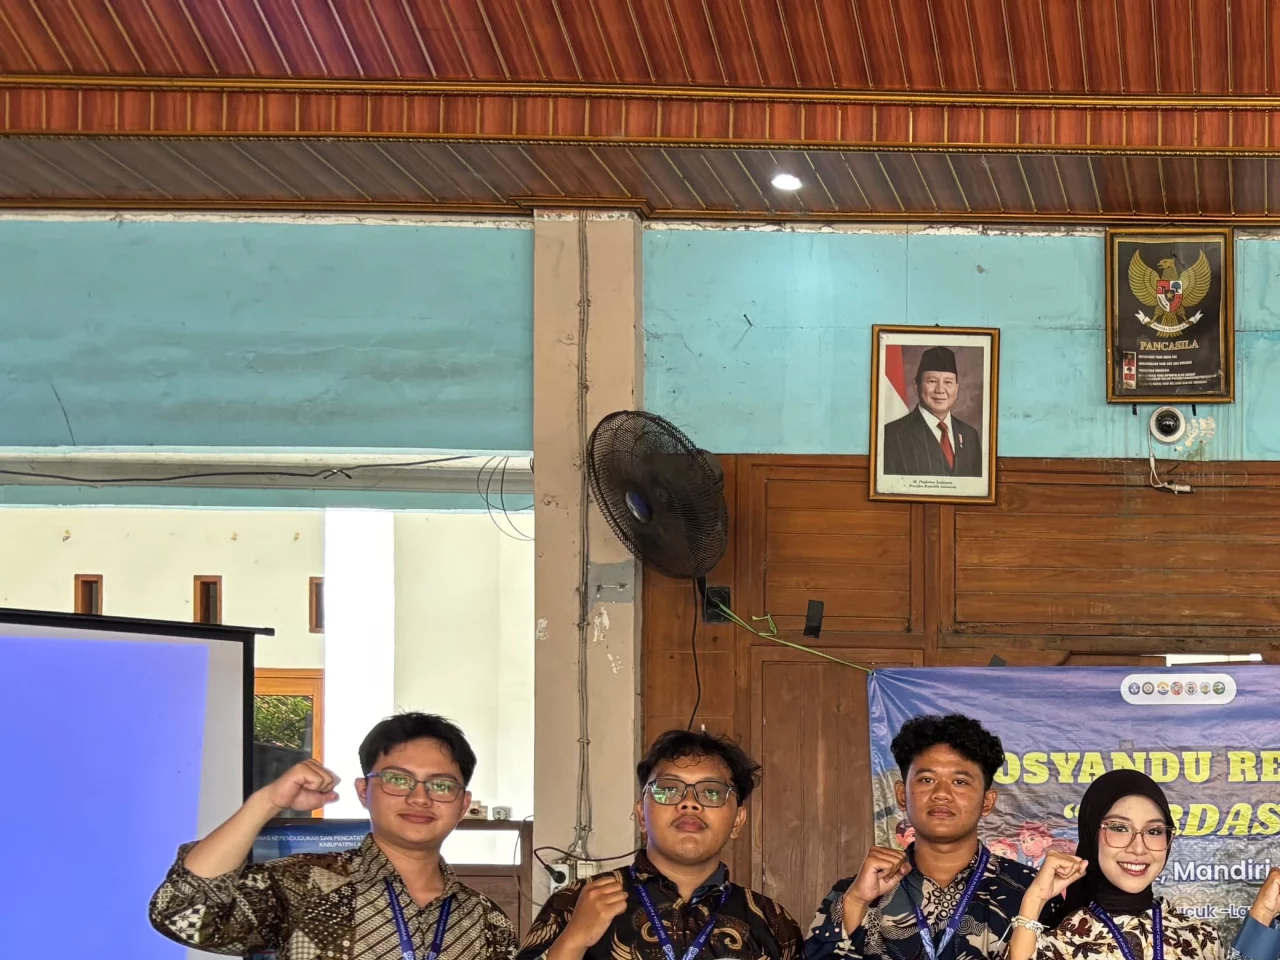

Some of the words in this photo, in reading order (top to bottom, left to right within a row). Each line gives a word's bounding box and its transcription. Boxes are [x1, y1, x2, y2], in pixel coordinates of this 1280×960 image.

[1139, 340, 1199, 351] PANCASILA
[993, 751, 1212, 784] OSYANDU
[1173, 858, 1271, 881] Mandiri
[1178, 904, 1216, 918] ucuk
